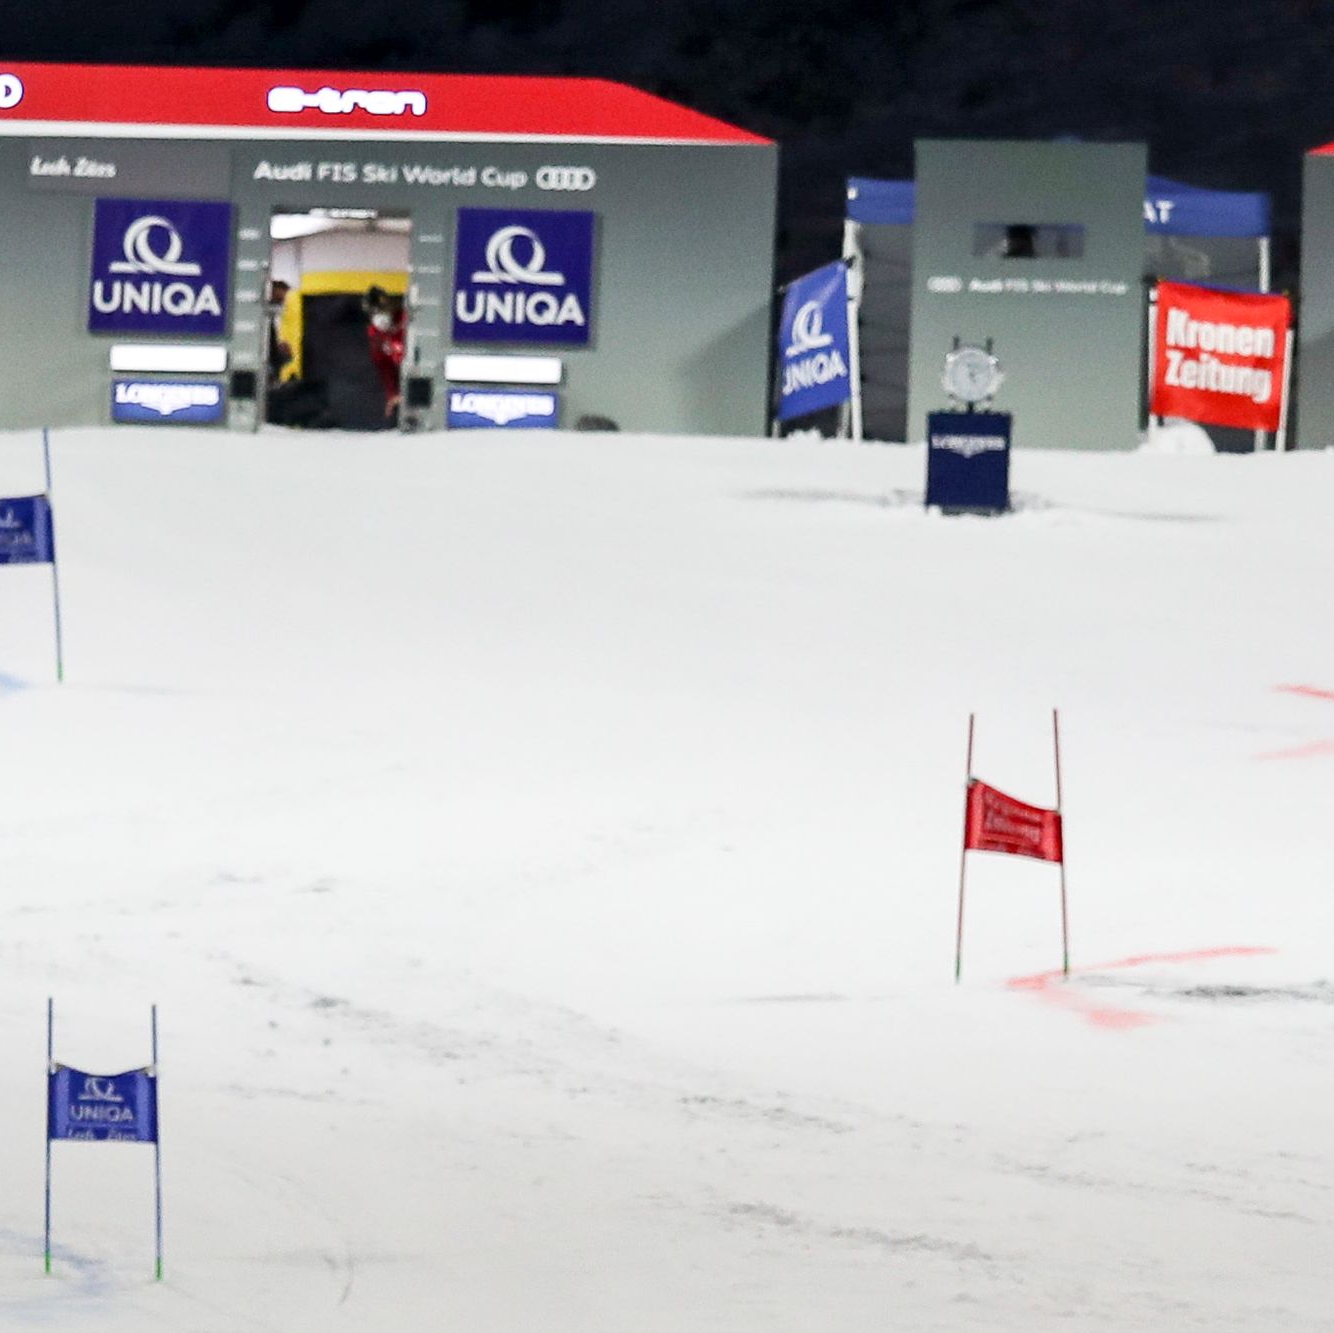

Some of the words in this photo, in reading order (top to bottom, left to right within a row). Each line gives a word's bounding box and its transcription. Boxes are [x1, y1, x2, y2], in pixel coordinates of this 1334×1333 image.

[267, 86, 428, 116] e-tron
[253, 161, 313, 182] Audi
[318, 163, 357, 184] FIS
[362, 164, 398, 185] Ski
[402, 166, 477, 187] World
[480, 166, 529, 191] Cup
[93, 280, 221, 316] UNIQA
[456, 289, 586, 326] UNIQA
[1167, 308, 1275, 358] Kronen
[1165, 350, 1273, 404] Zeitung
[70, 1104, 134, 1122] UNIQA
